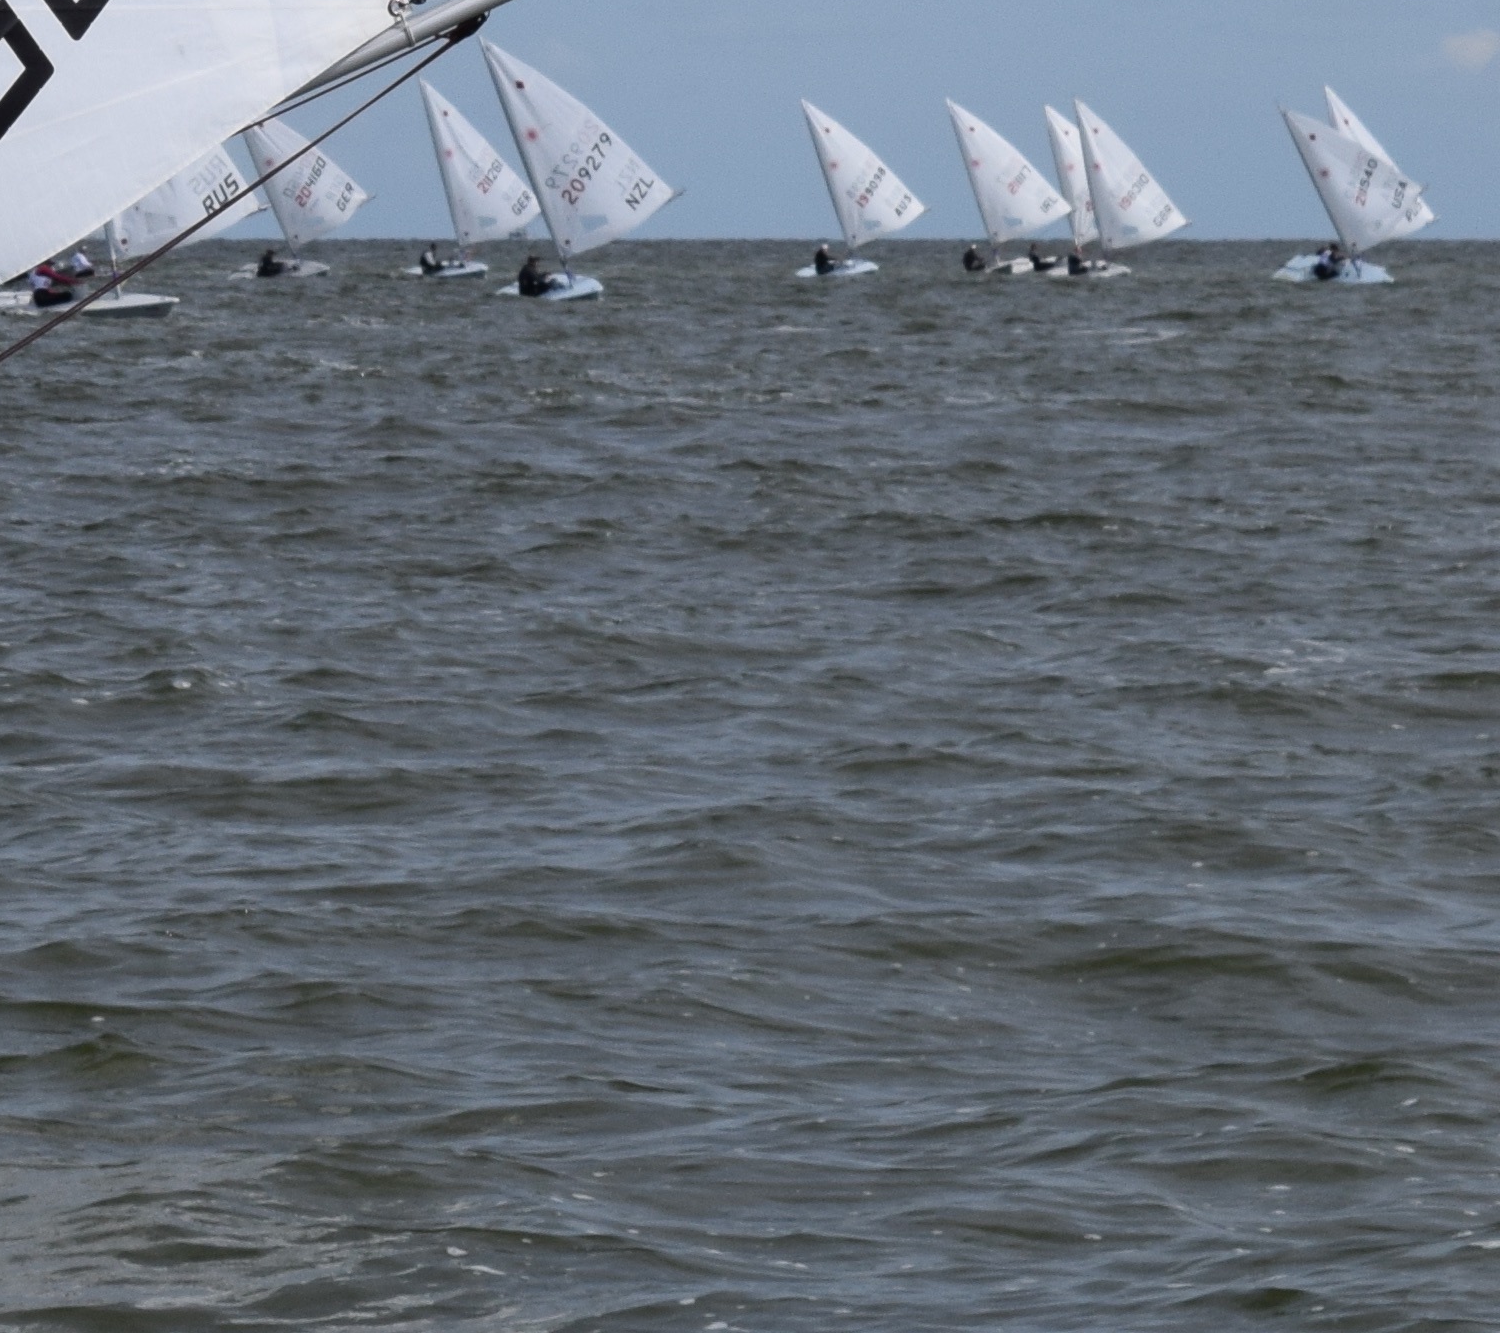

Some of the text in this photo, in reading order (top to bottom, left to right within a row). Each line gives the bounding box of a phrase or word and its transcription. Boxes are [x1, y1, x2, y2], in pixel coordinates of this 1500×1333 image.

[295, 156, 327, 208] 204160
[561, 132, 612, 206] 209279
[202, 173, 241, 215] RUS
[336, 182, 354, 212] GER
[511, 190, 533, 217] GER
[625, 179, 655, 211] NZL
